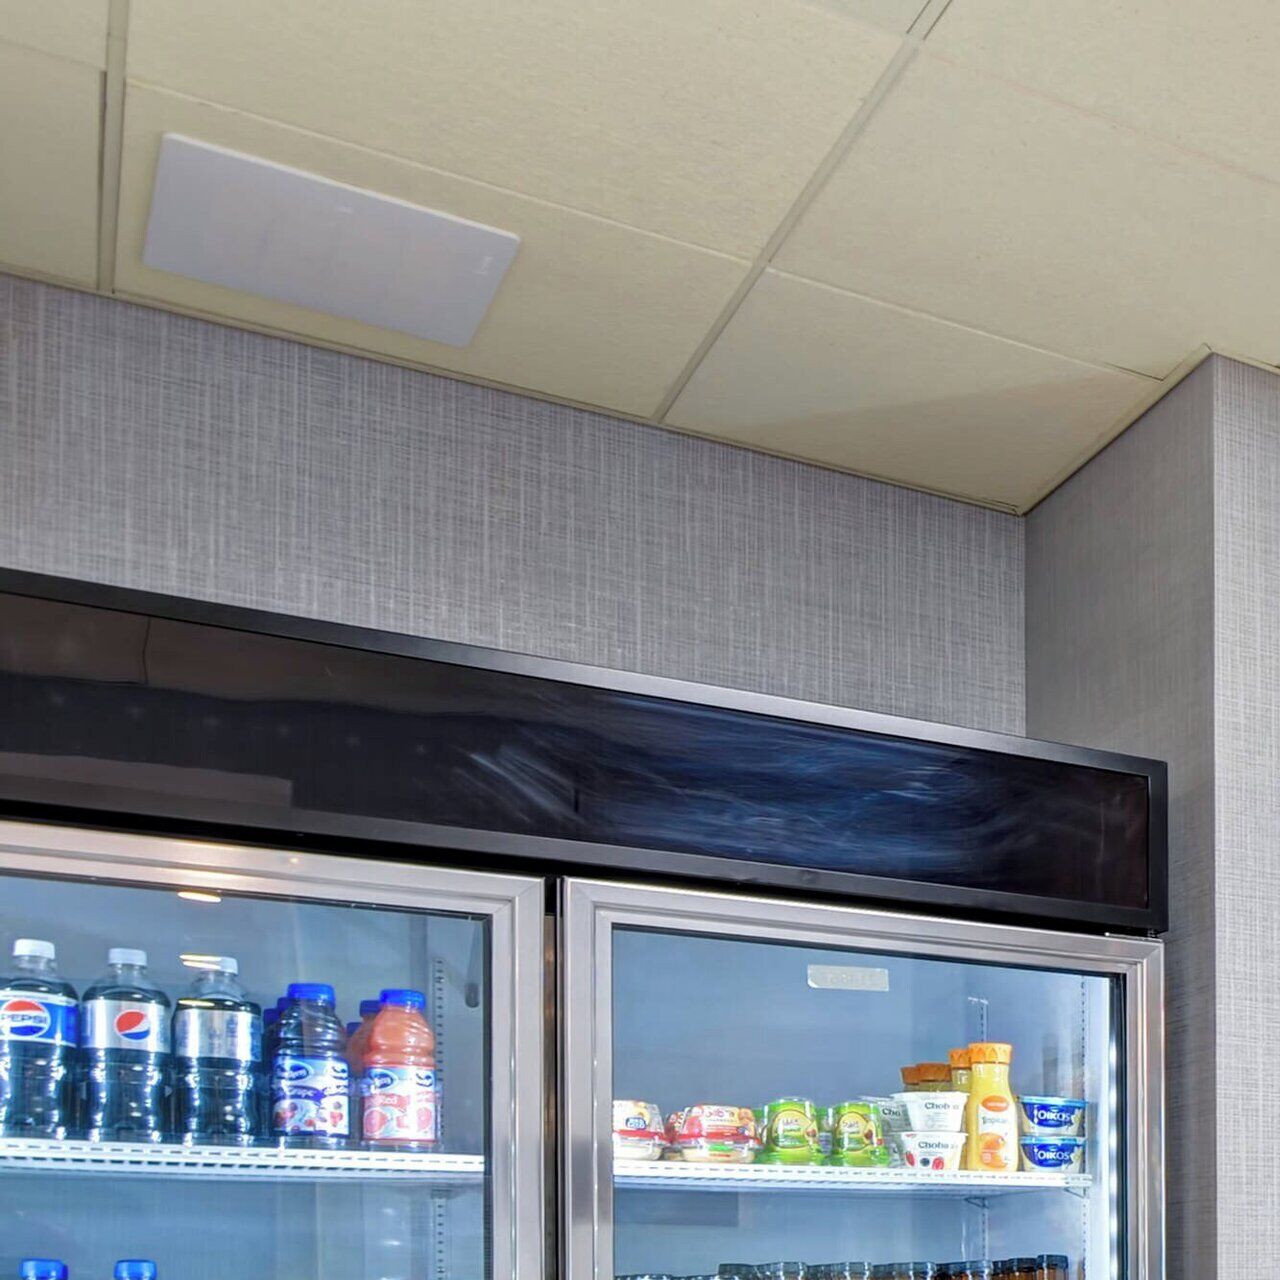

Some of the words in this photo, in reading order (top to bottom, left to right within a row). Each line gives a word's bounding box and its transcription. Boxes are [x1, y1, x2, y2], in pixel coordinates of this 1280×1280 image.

[0, 1013, 47, 1024] PEPSI
[1037, 1108, 1071, 1121] OIKOS
[1037, 1148, 1071, 1160] OIKOS
